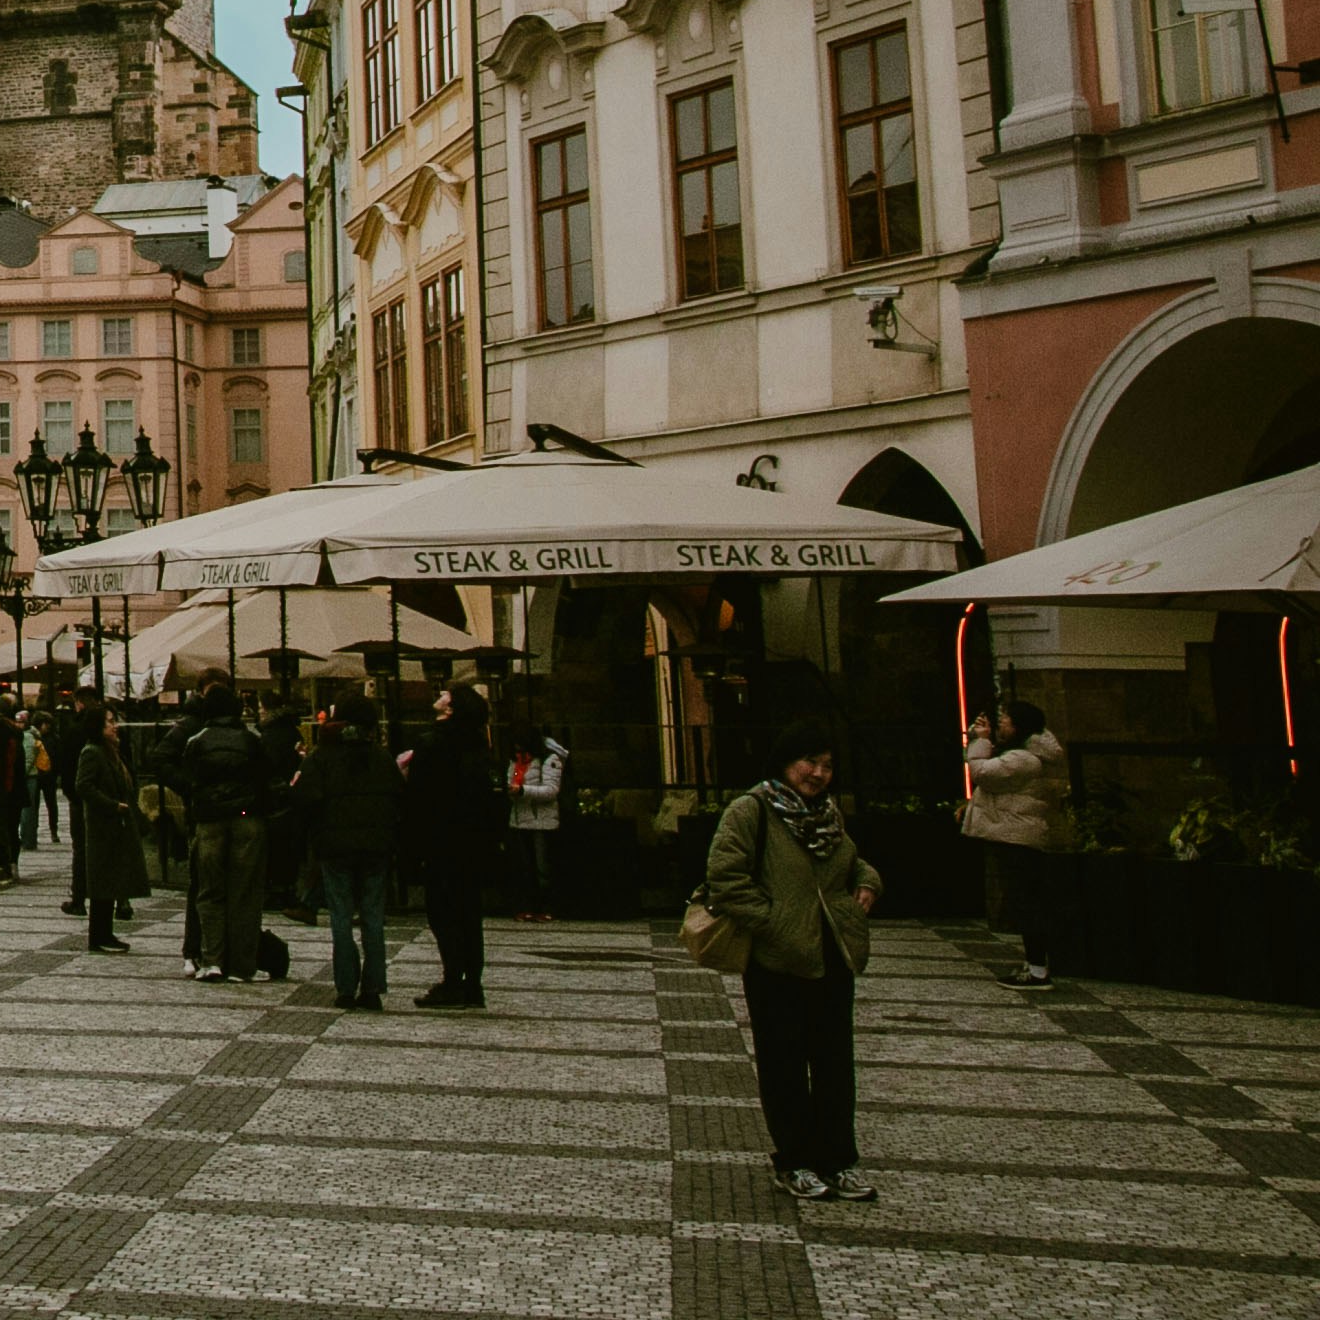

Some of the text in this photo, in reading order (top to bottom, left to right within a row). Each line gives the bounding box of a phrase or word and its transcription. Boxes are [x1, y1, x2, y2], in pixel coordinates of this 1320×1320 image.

[414, 546, 613, 574] STEAK & GRILL
[676, 543, 876, 567] STEAK & GRILL
[94, 575, 100, 592] &
[103, 572, 124, 592] GRILL
[201, 561, 271, 584] STEAK & GRILL
